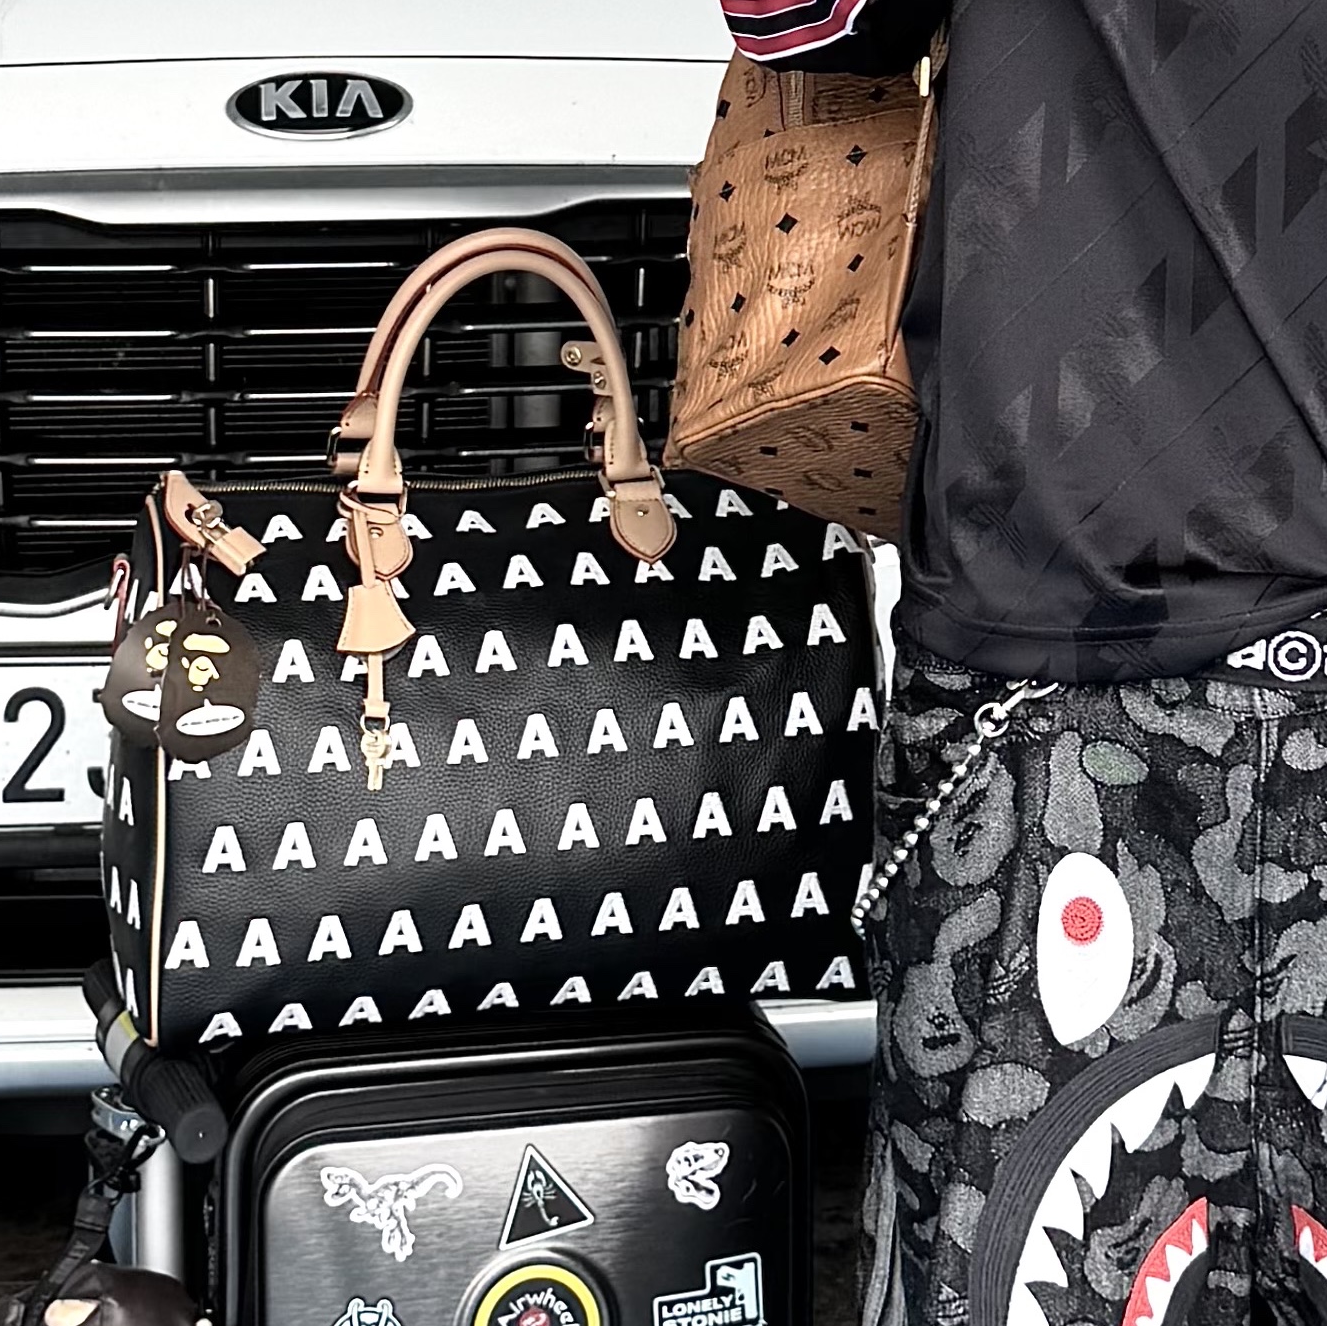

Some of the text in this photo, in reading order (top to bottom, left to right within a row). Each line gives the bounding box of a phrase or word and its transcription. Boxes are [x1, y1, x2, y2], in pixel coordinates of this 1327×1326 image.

[259, 79, 383, 122] KIA
[764, 145, 807, 172] MCM
[767, 261, 815, 283] MCM
[260, 514, 303, 544] A
[455, 509, 497, 533] A
[525, 502, 567, 529] A
[715, 489, 753, 518] A
[234, 572, 278, 603] A
[301, 564, 344, 602] A
[433, 562, 477, 597] A
[502, 554, 544, 589] A
[570, 551, 611, 586] A
[697, 546, 737, 582] A
[760, 542, 800, 578] A
[822, 522, 866, 561] A
[271, 638, 316, 684] A
[407, 634, 451, 678] A
[474, 629, 518, 674] A
[546, 623, 590, 668] A
[613, 619, 655, 663] A
[678, 618, 719, 660] A
[742, 614, 784, 655] A
[806, 603, 847, 646] A
[2, 686, 107, 804] 2
[236, 728, 282, 778] A
[304, 725, 352, 775] A
[445, 718, 490, 765] A
[516, 713, 560, 760] A
[586, 708, 629, 755] A
[652, 702, 695, 749] A
[718, 696, 760, 743] A
[784, 691, 824, 737] A
[846, 687, 880, 732] A
[201, 779, 853, 874] A A A A A A A A A A
[164, 920, 210, 970] A
[235, 917, 282, 968] A
[307, 914, 352, 963] A
[378, 909, 423, 956] A
[448, 903, 492, 950] A
[519, 897, 563, 943] A
[590, 891, 634, 937] A
[658, 887, 700, 932] A
[725, 879, 766, 926] A
[790, 871, 830, 918] A
[198, 955, 856, 1044] A A A A A A A A A A
[661, 1293, 735, 1319] LONELY
